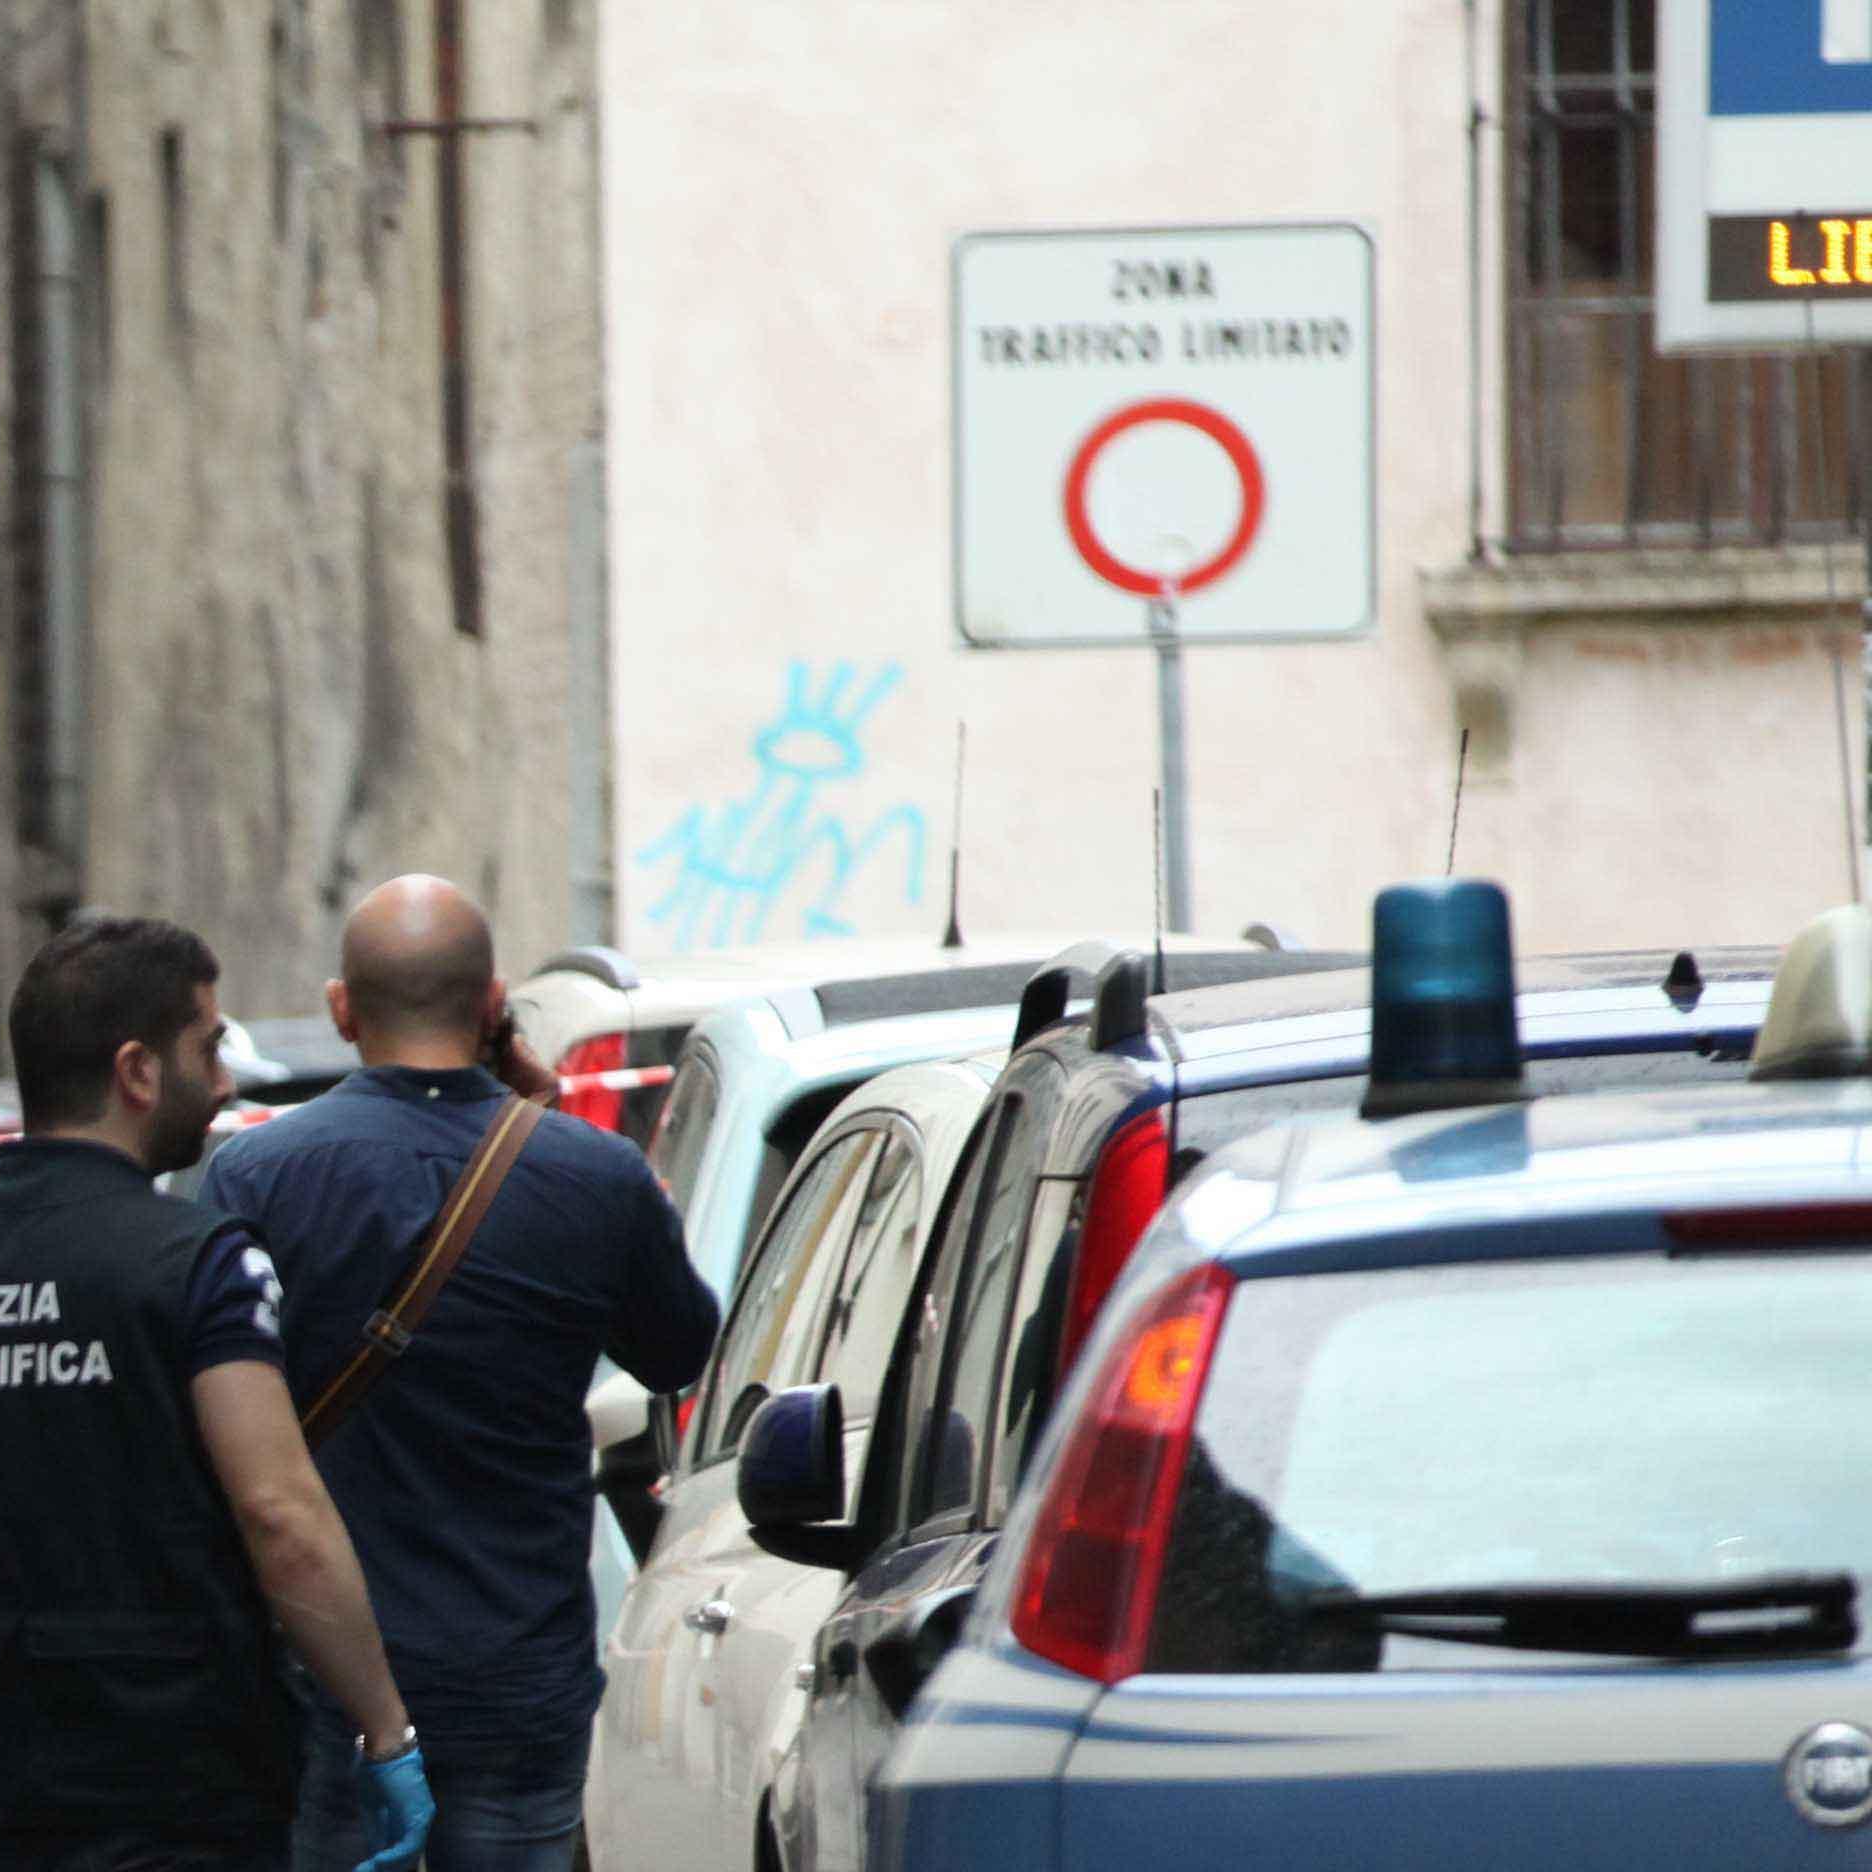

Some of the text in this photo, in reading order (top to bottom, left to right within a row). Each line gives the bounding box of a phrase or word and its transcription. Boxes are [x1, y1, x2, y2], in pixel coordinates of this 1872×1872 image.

[1112, 259, 1217, 299] ZONA
[980, 316, 1352, 365] TRAFFICO LIMITATO
